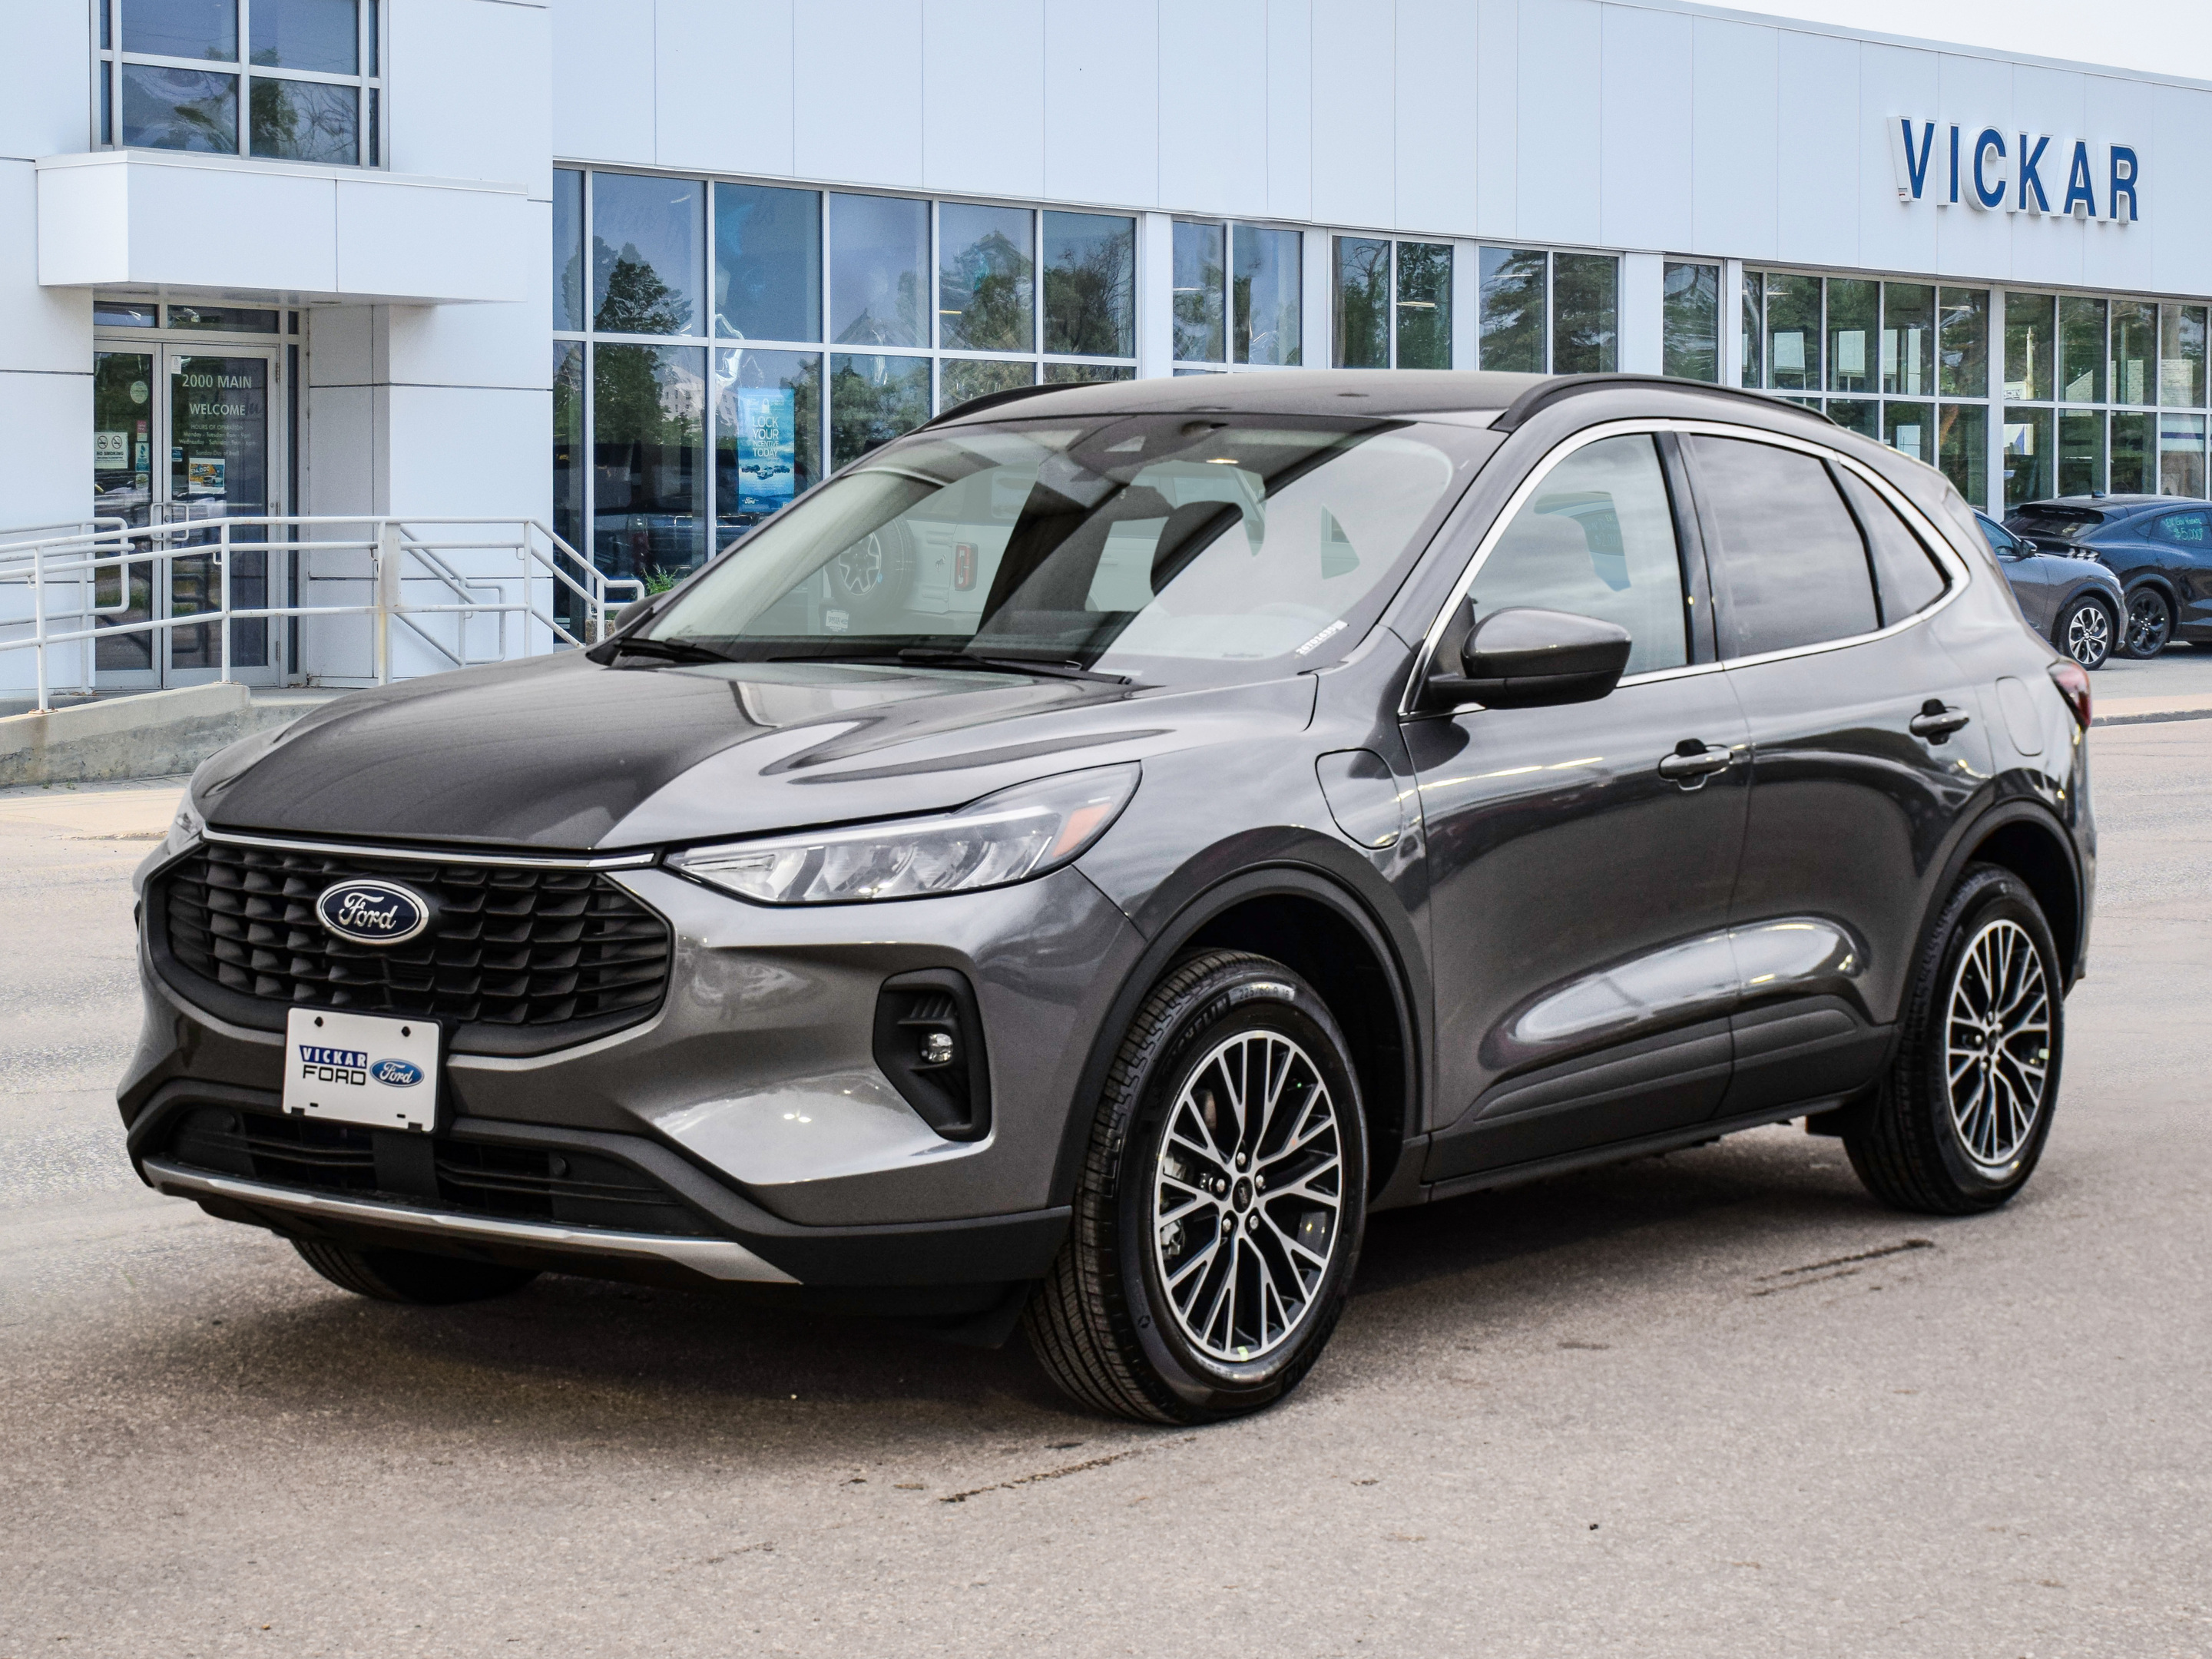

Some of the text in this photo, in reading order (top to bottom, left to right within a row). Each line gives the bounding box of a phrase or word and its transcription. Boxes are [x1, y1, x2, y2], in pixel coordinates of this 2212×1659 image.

[1899, 115, 2139, 223] VICKAR
[182, 374, 252, 389] 2000 MAIN
[189, 403, 246, 416] WELCOME
[752, 416, 779, 428] LOCK
[752, 429, 780, 439] YOUR
[753, 448, 778, 457] TODAY
[338, 892, 399, 930] Ford
[302, 1045, 367, 1068] VICKAR
[303, 1065, 366, 1086] FORD
[379, 1061, 414, 1084] Ford
